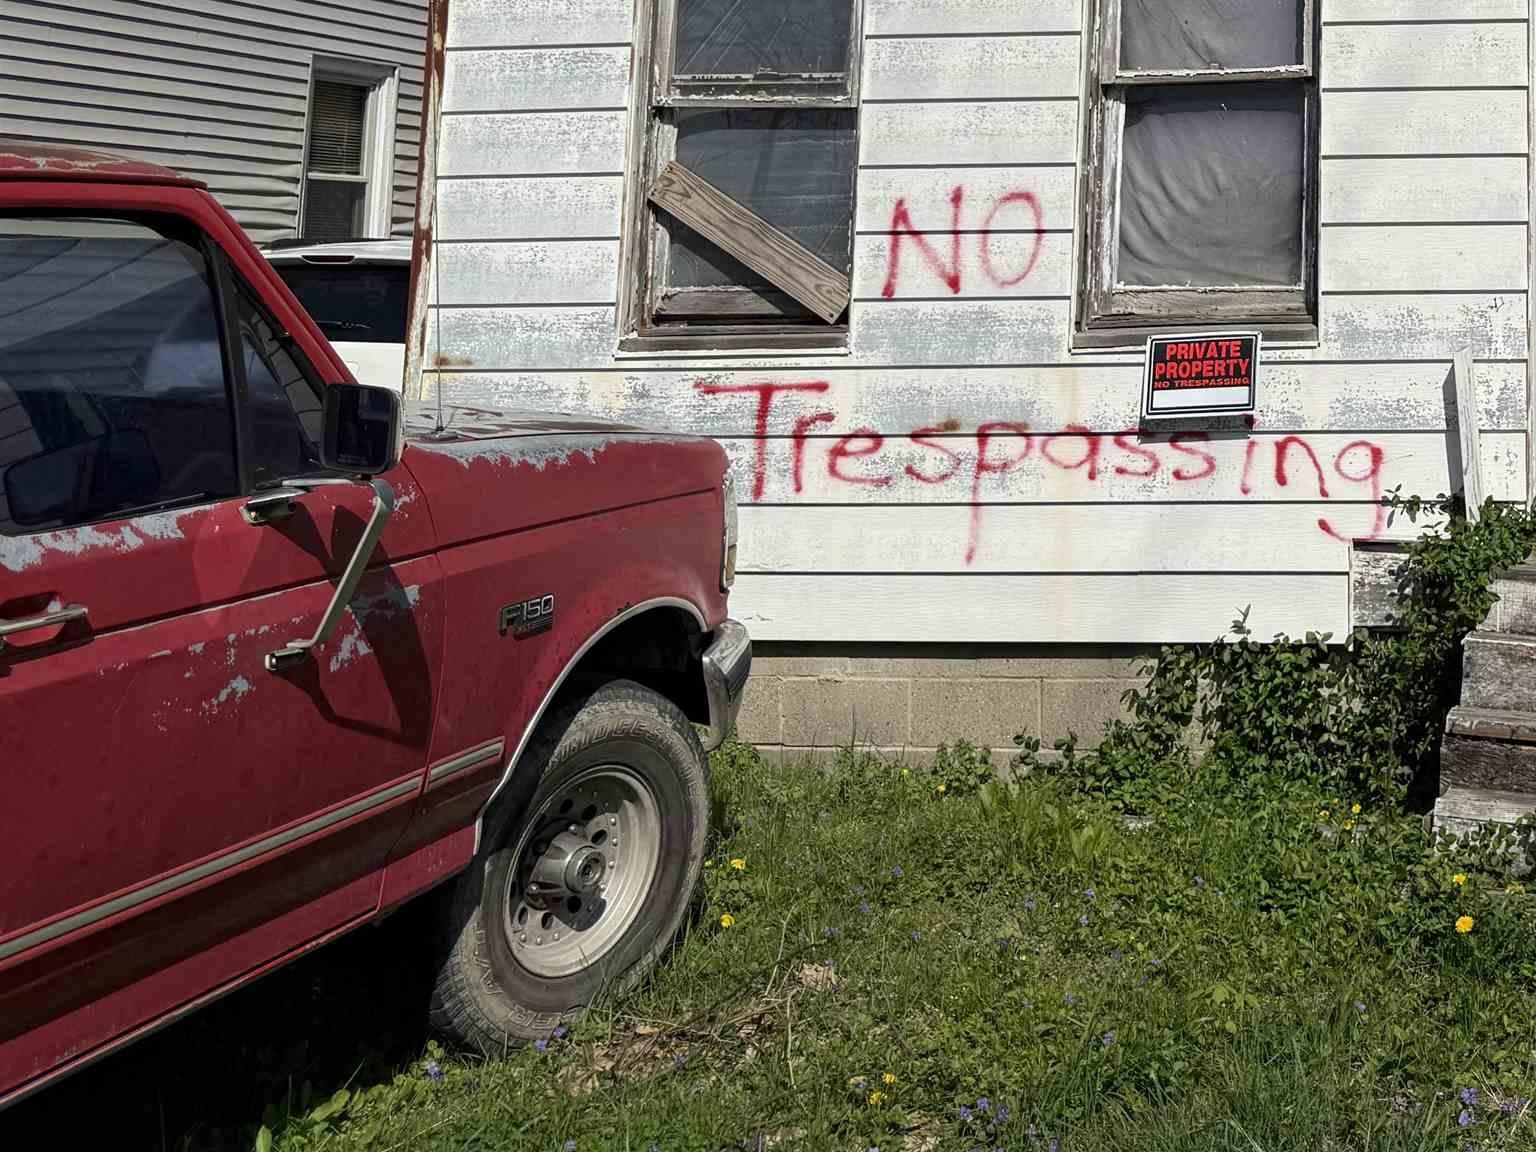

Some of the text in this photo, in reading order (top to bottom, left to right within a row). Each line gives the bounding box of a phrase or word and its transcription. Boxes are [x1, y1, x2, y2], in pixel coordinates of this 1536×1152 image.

[881, 185, 1045, 298] NO
[1166, 341, 1241, 360] PRIVATE
[1155, 359, 1249, 379] PROPERTY
[1154, 378, 1249, 389] NO TRESPASSING
[692, 377, 1384, 563] Trespassing
